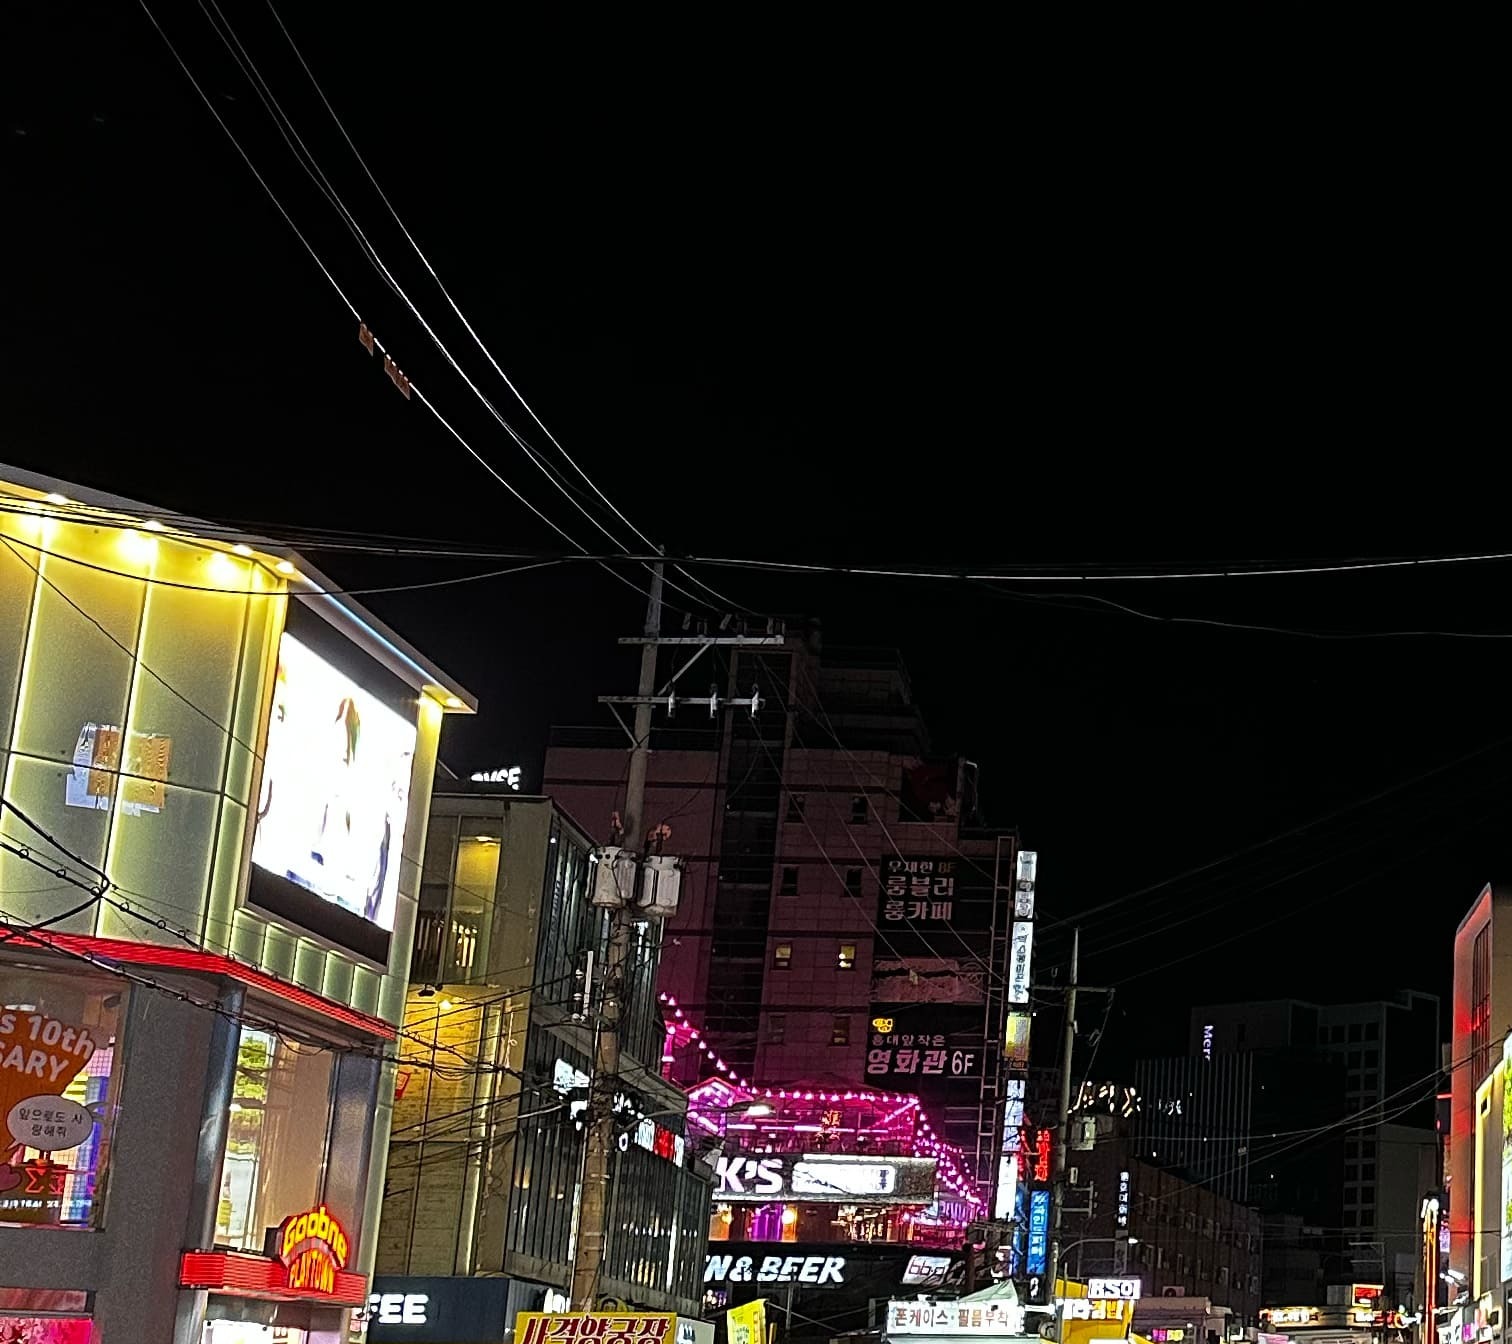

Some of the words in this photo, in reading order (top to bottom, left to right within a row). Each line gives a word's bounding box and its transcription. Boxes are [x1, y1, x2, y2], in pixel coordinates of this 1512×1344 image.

[28, 1015, 95, 1060] 10th
[867, 1049, 948, 1075] 영화관
[951, 1050, 975, 1075] 6F
[284, 1207, 348, 1268] Goobne
[288, 1251, 335, 1295] PLAYTOWN
